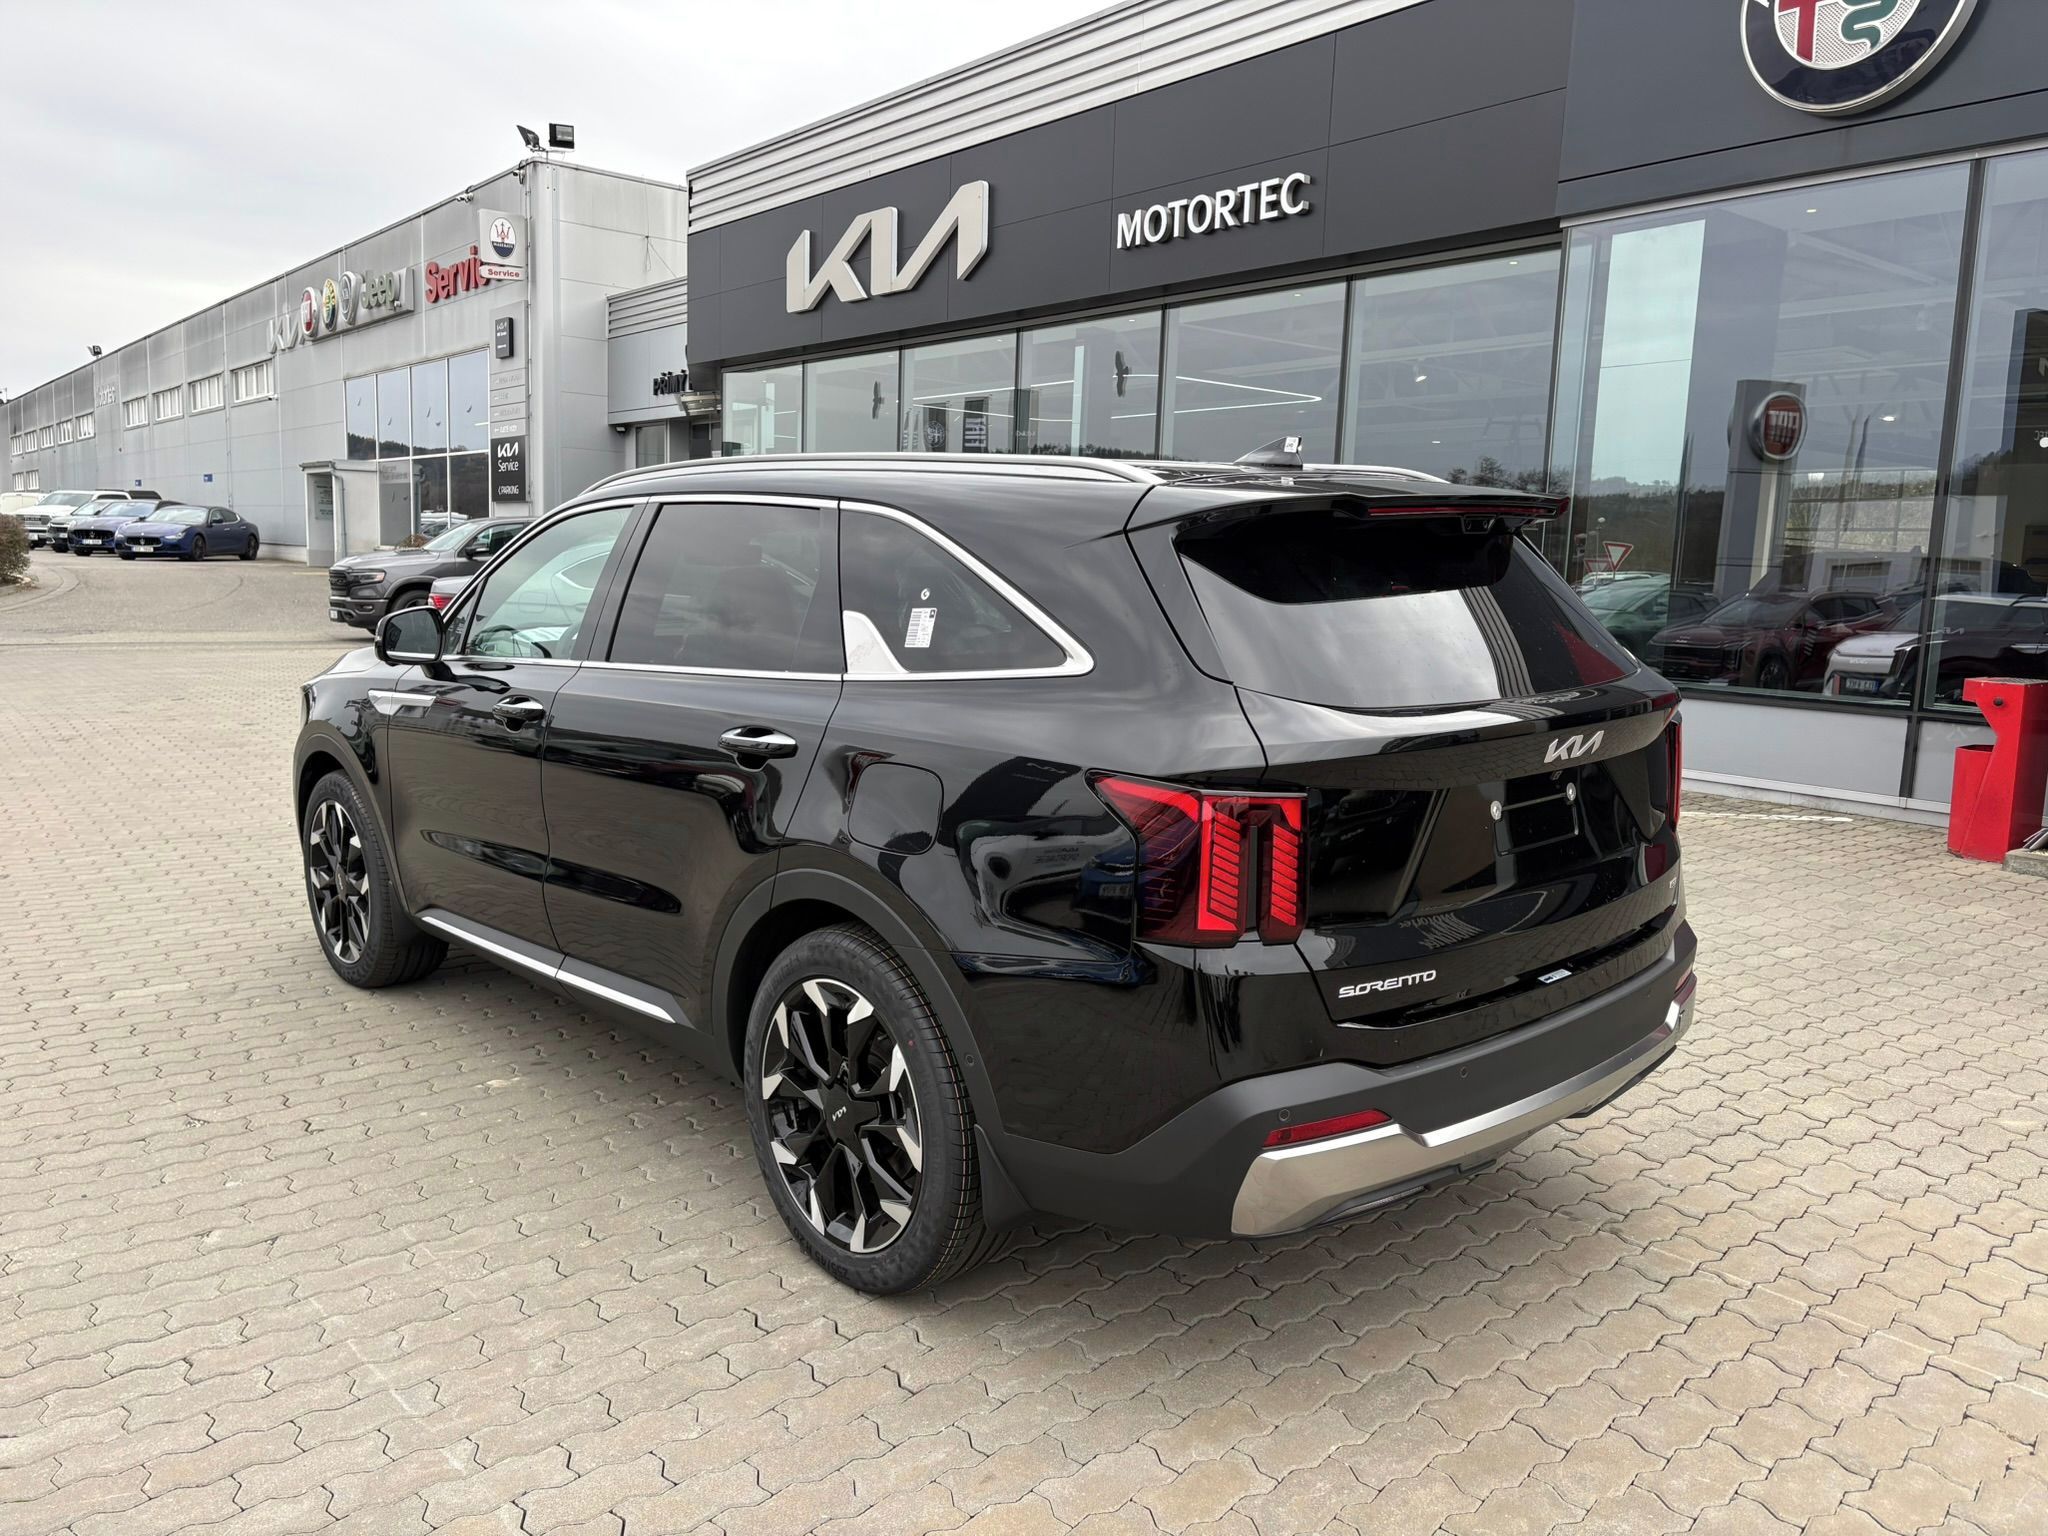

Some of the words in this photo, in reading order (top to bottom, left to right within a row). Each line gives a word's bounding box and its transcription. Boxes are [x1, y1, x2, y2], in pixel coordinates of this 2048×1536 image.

[1116, 171, 1311, 250] MOTORTEC
[786, 180, 989, 313] KIA
[488, 268, 520, 278] Service
[360, 271, 395, 309] Jeep
[497, 441, 519, 458] KIA
[497, 459, 519, 472] Service
[1543, 729, 1605, 764] KIA
[1337, 969, 1437, 999] SORENTO
